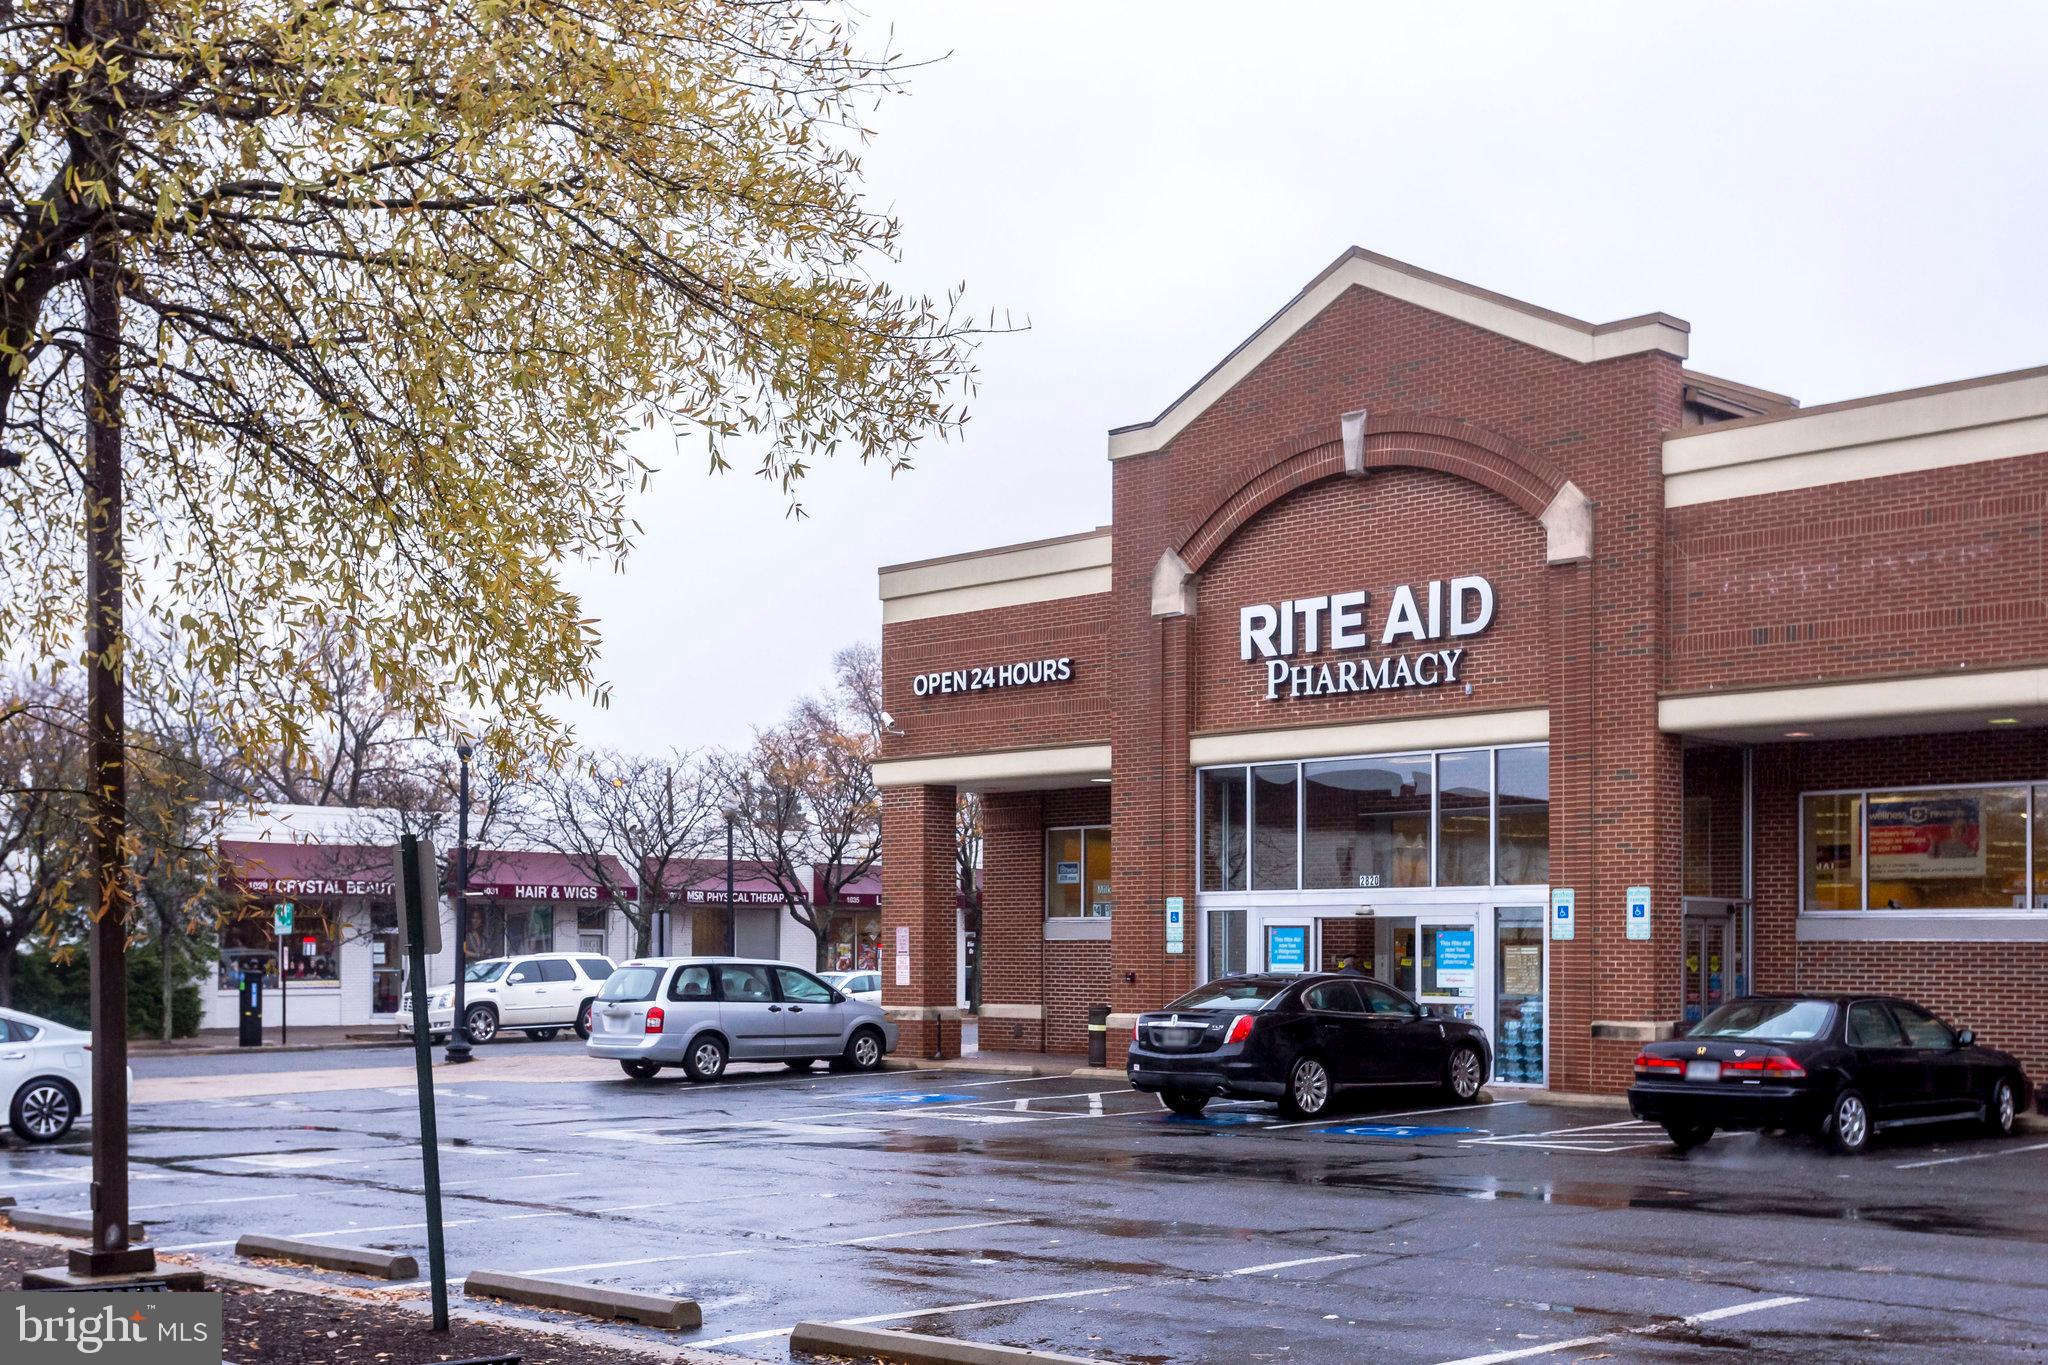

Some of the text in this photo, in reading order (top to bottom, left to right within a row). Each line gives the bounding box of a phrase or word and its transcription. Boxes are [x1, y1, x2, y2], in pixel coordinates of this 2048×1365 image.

[1240, 575, 1494, 660] RITE AID
[913, 657, 1071, 696] OPEN 24 HOURS
[1265, 649, 1463, 700] PHARMACY
[275, 880, 343, 894] CRYSTAL
[346, 881, 396, 895] BEAUT
[1360, 875, 1380, 886] 2820
[515, 885, 548, 899] HAIR
[551, 886, 560, 899] &
[564, 886, 598, 899] WIGS
[687, 890, 705, 901] MSR
[707, 892, 749, 903] PHYSCAL
[751, 893, 789, 904] THERAP
[846, 896, 860, 904] 1035
